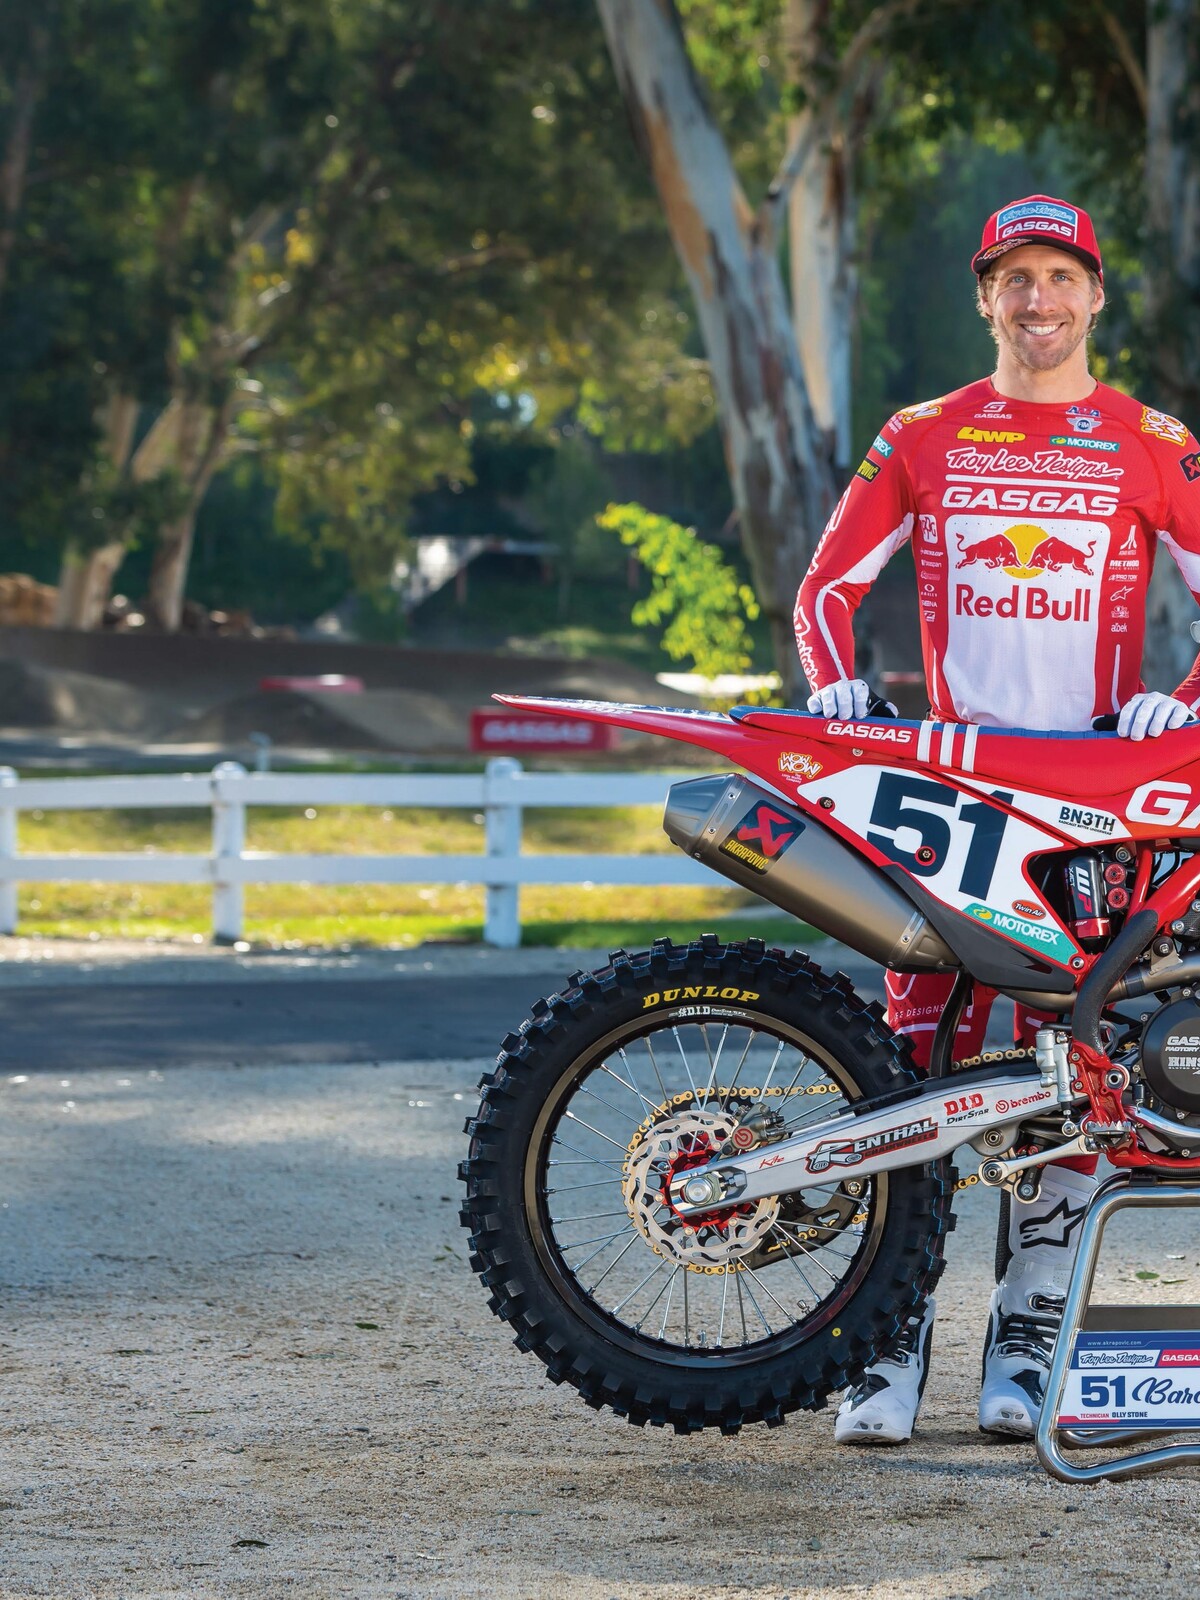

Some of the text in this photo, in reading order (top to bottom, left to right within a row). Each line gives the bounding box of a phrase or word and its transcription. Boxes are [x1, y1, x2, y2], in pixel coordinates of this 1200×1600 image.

[1002, 221, 1073, 238] GASGAS
[957, 426, 1026, 444] 4WP
[1067, 437, 1117, 451] MOTOREX
[946, 446, 1125, 481] Troy Lee Designs
[942, 486, 1120, 517] GASGAS
[955, 583, 1091, 622] Red Bull
[827, 722, 913, 744] GASGAS
[1059, 805, 1117, 832] BN3TH
[866, 770, 1015, 902] 51
[1015, 902, 1044, 917] Twin Air
[993, 913, 1060, 945] MOTOREX
[642, 985, 760, 1009] DUNLOP
[906, 1004, 945, 1018] DESIGNS
[1010, 1090, 1052, 1109] brembo
[1080, 1351, 1154, 1366] Troy Lee Designs
[1081, 1375, 1127, 1408] 51
